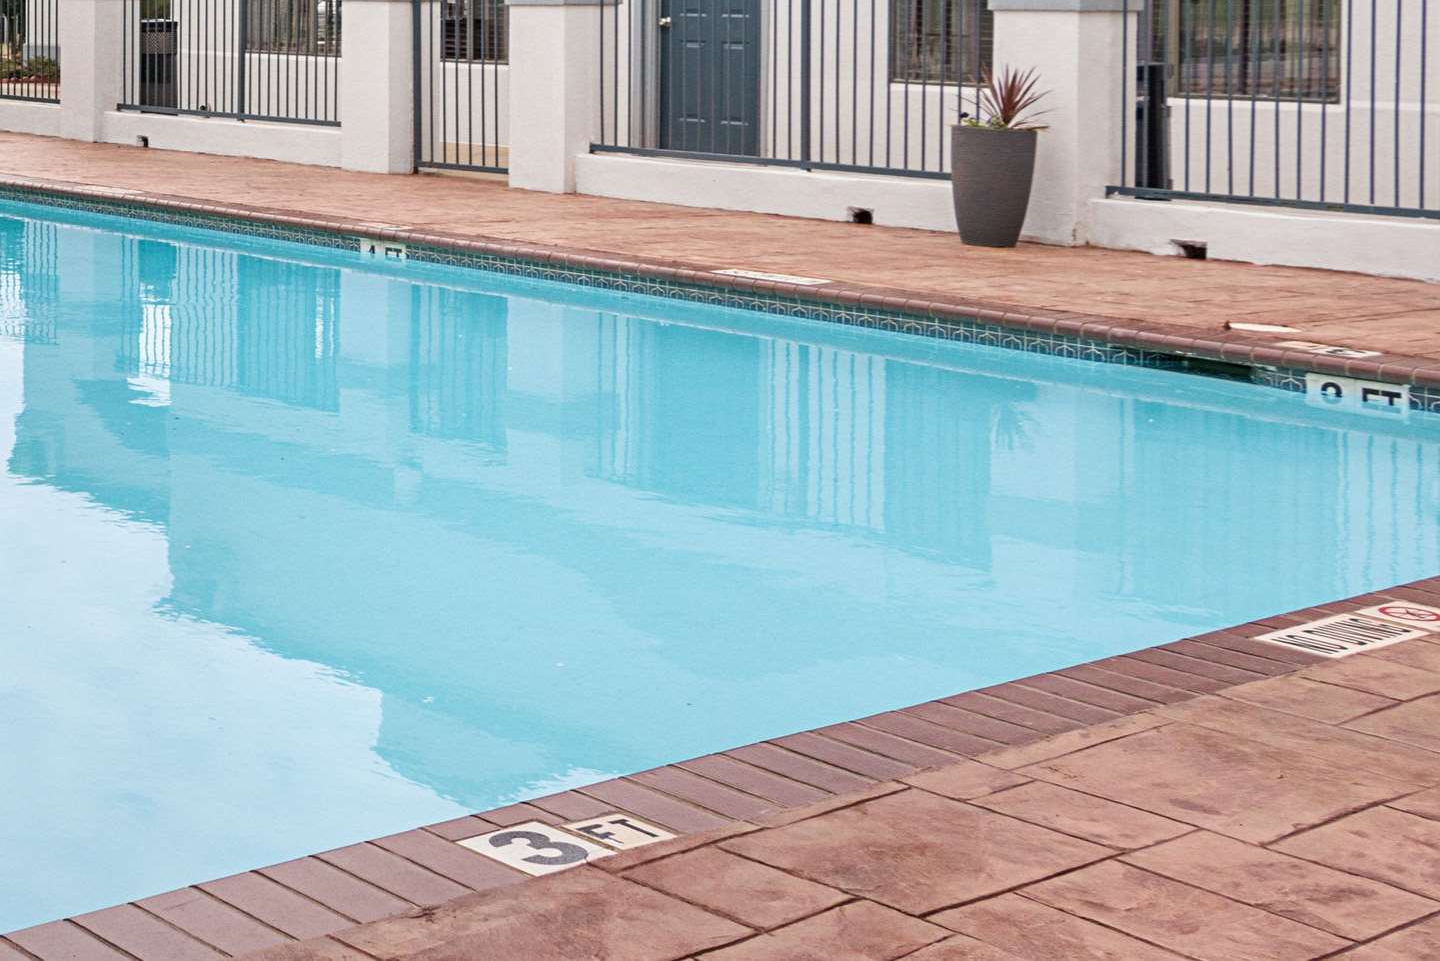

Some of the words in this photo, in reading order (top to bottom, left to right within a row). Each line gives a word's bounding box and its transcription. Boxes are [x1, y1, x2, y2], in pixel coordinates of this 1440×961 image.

[1271, 634, 1348, 655] NO
[1302, 617, 1412, 647] DIVING
[489, 830, 589, 866] 3
[575, 818, 660, 845] FT
